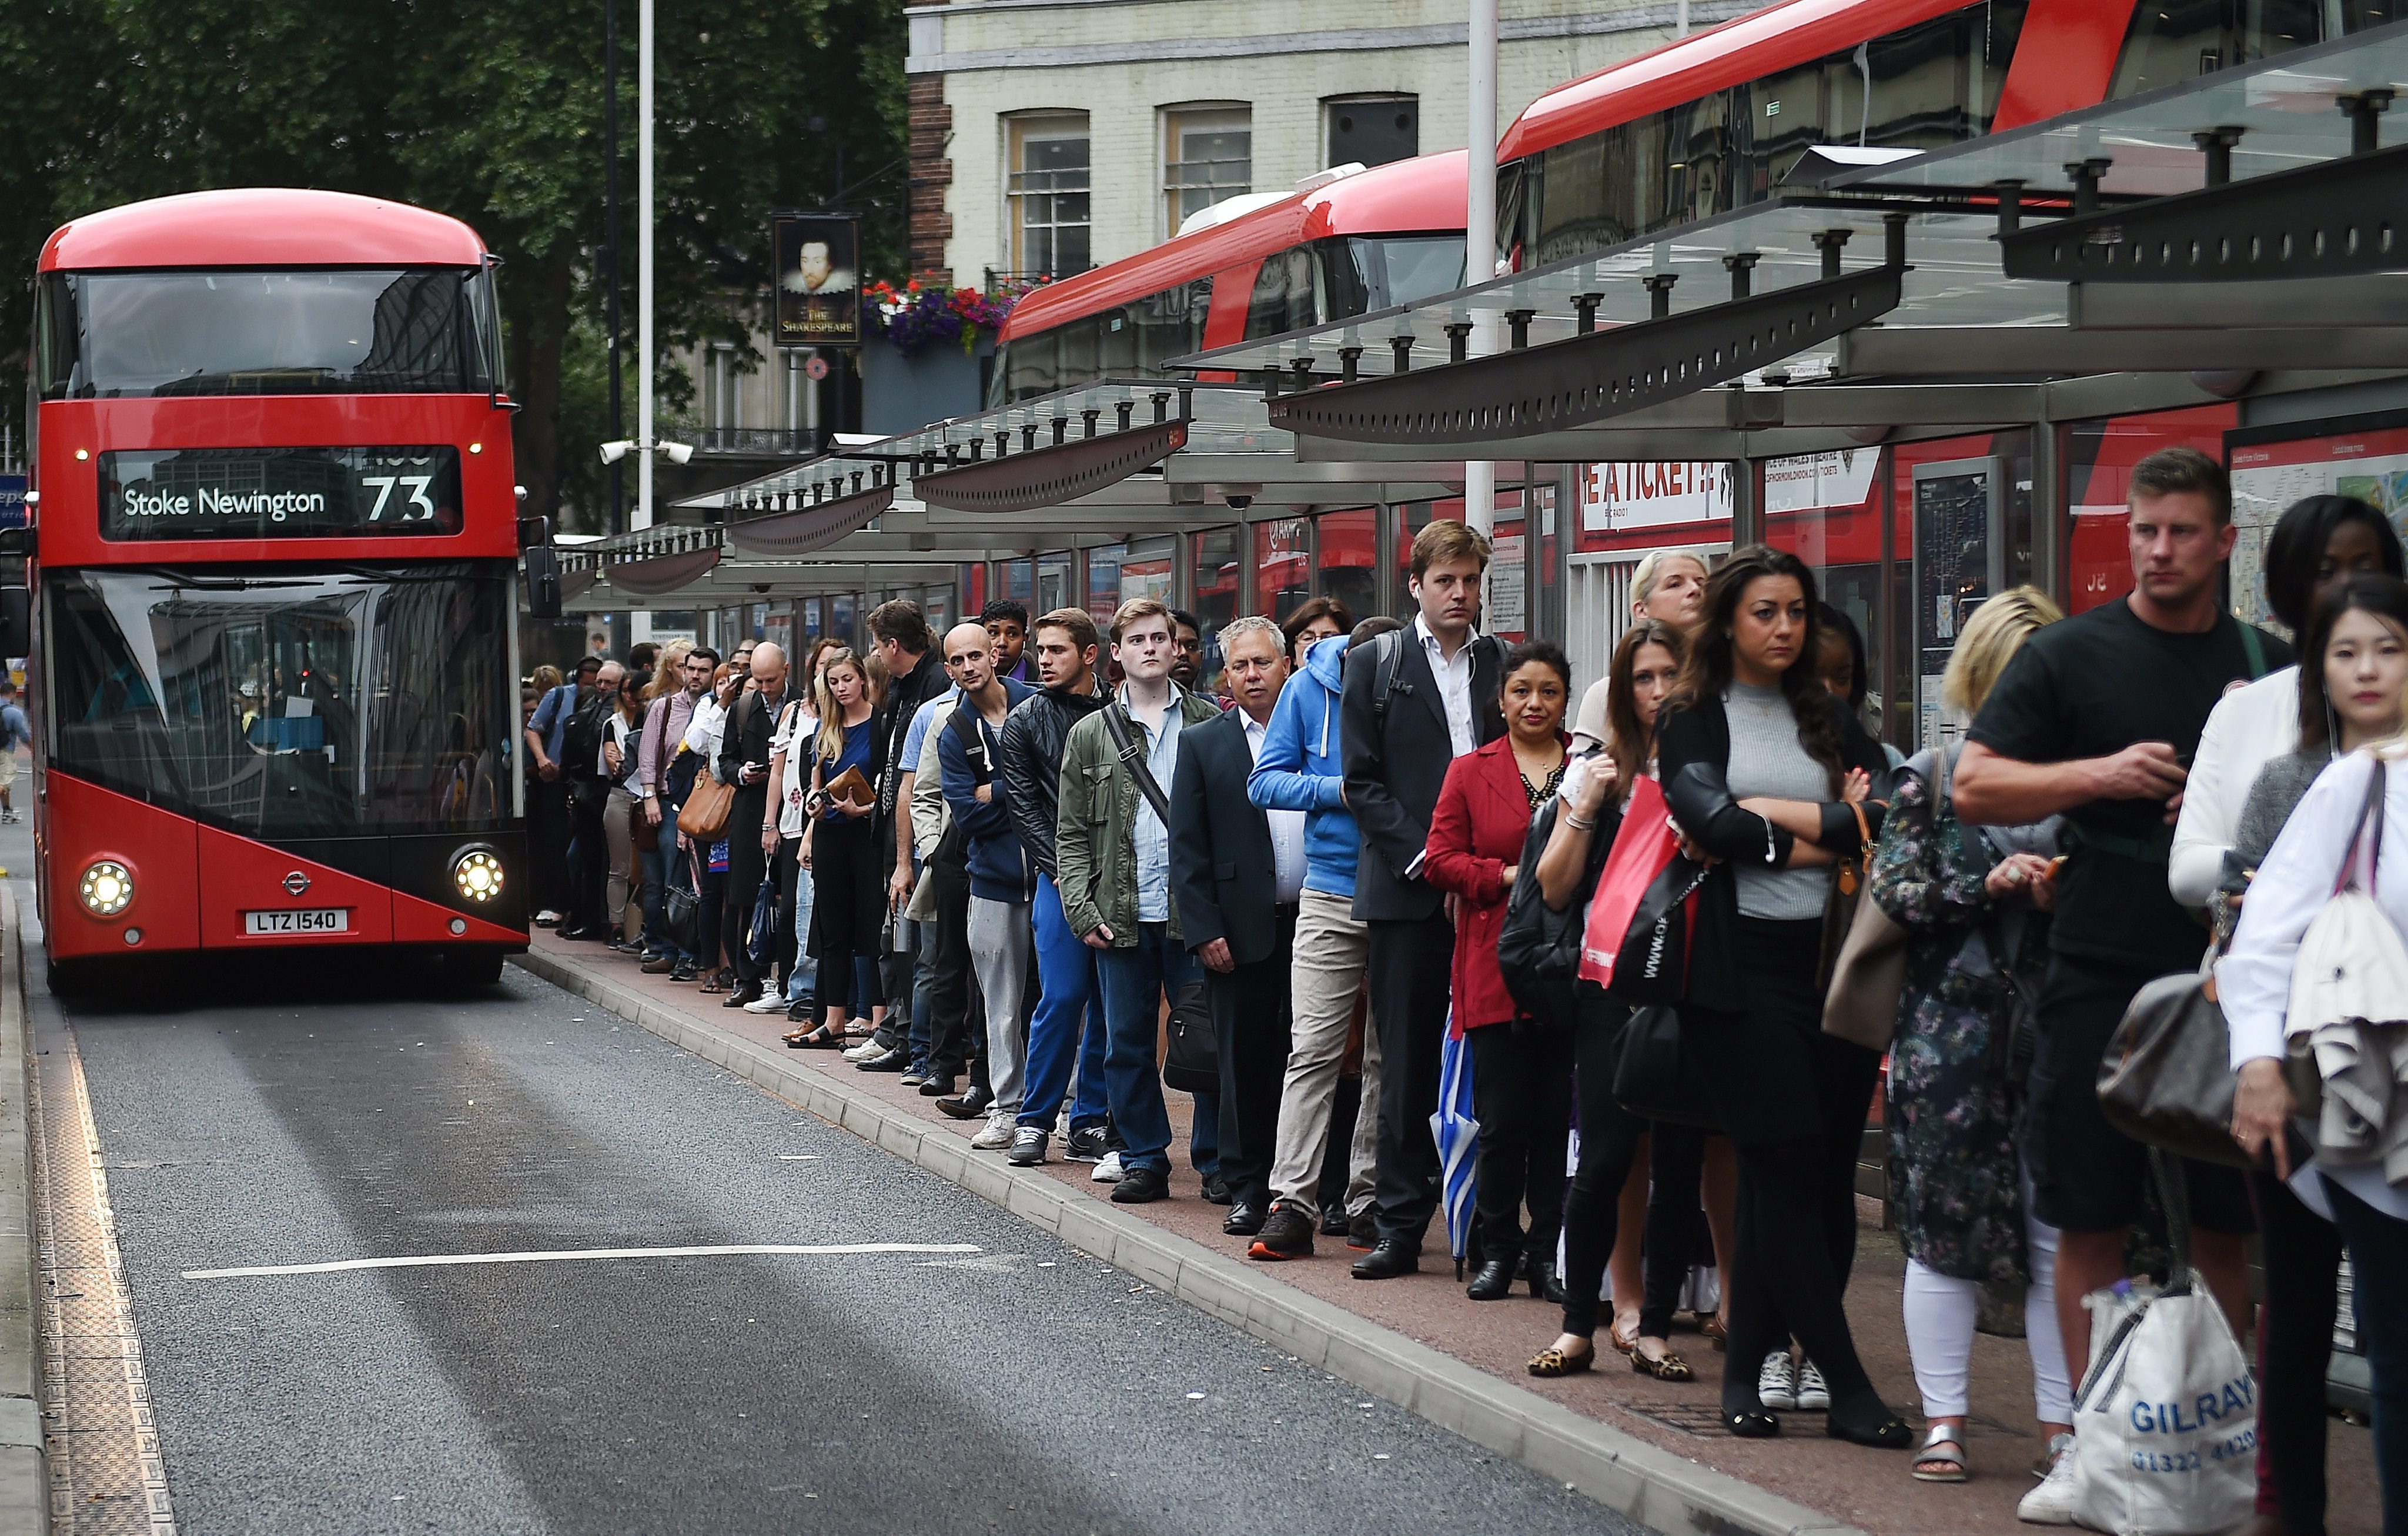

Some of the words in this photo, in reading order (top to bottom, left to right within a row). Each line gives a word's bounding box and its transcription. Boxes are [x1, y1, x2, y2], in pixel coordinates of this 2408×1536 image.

[125, 488, 189, 516] Stoke
[198, 487, 324, 522] Newington
[362, 475, 434, 520] 73
[257, 914, 292, 931] LTZ
[296, 912, 336, 930] 1540
[2131, 1374, 2253, 1433] GILRAY
